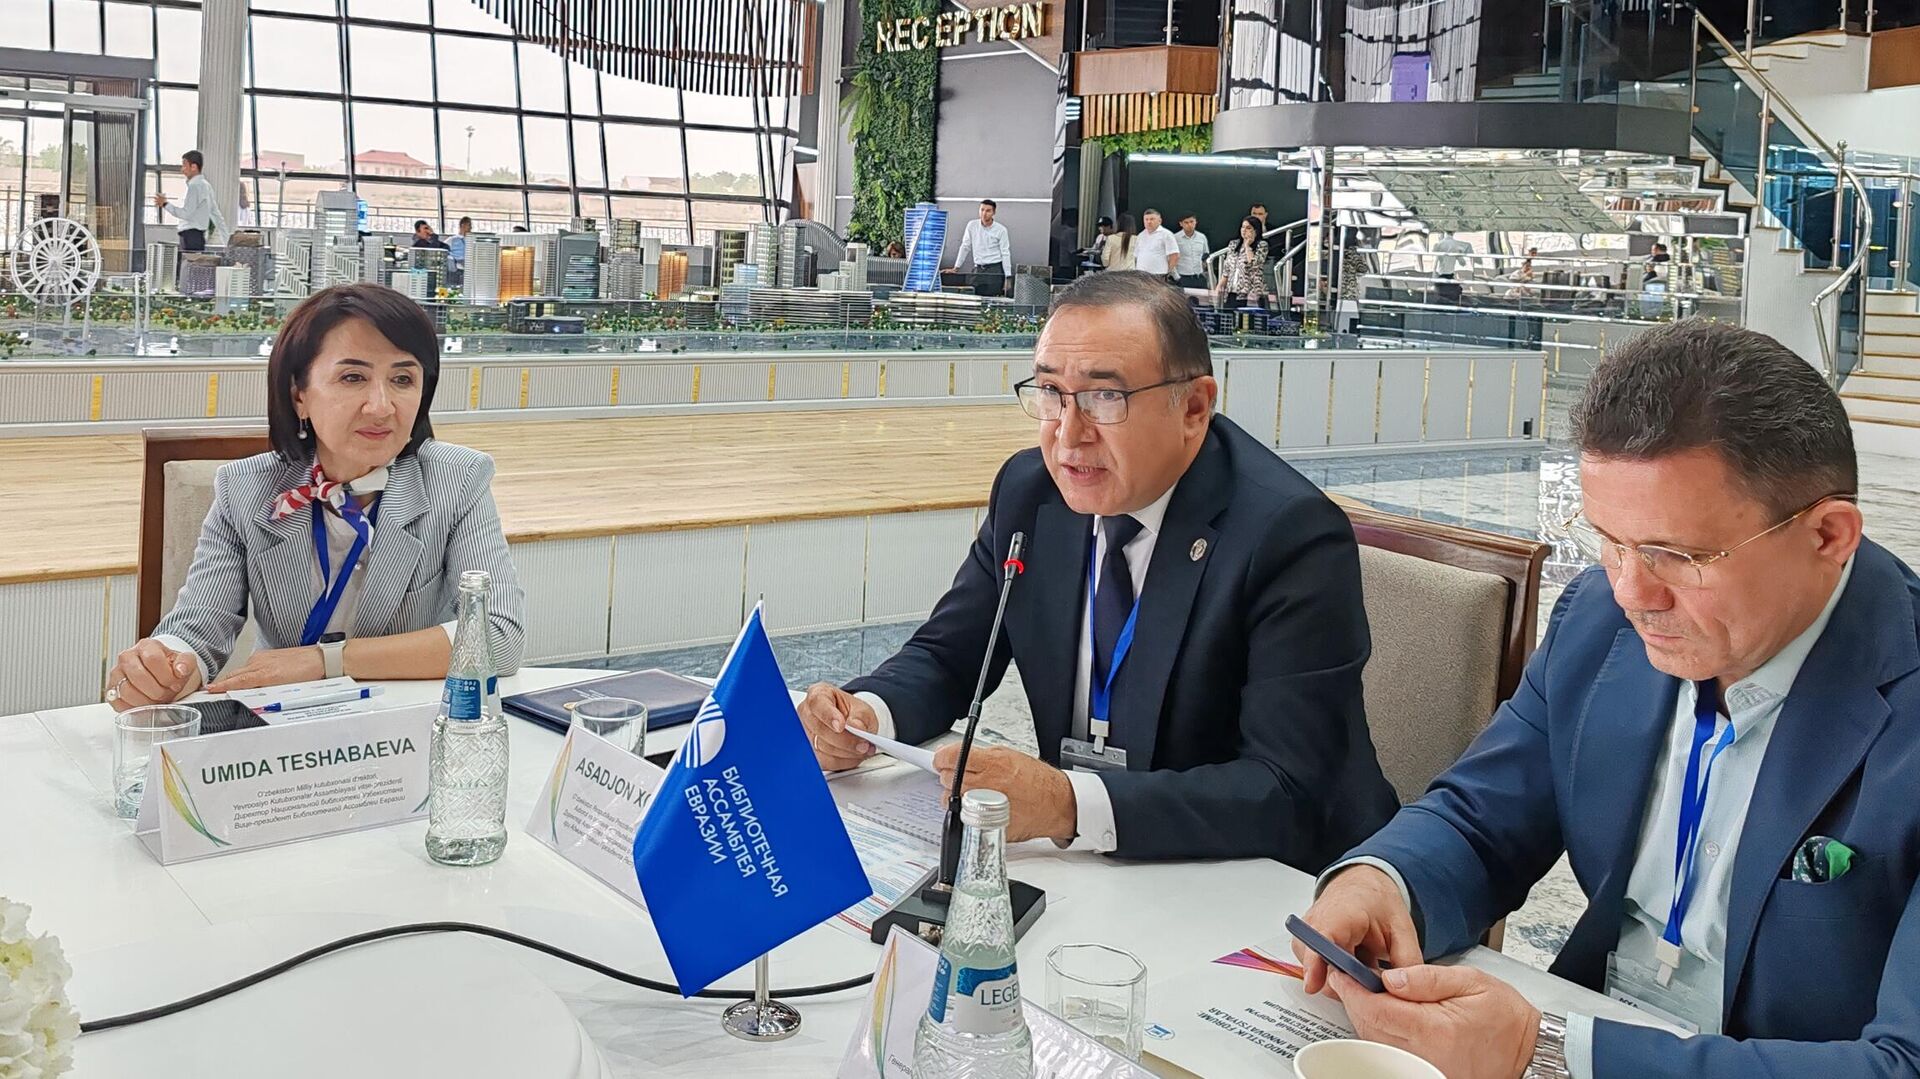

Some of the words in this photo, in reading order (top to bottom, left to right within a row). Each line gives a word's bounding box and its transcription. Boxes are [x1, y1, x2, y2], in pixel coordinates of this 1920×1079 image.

[876, 1, 1043, 53] RECEPTION
[201, 759, 273, 785] UMIDA
[277, 737, 416, 772] TESHABAEVA
[575, 757, 635, 801] ASADJON
[233, 809, 269, 821] Директор
[271, 800, 319, 813] Национальной
[684, 784, 728, 864] ЕВРАЗИИ
[702, 778, 757, 878] АССАМБЛЕЯ
[722, 766, 788, 897] БИБЛИОТЕЧНАЯ
[1208, 1007, 1287, 1046] INNOVATSIYALAR
[1244, 1007, 1277, 1023] ФОРУМ
[1234, 1029, 1294, 1061] AMDO'STLIK
